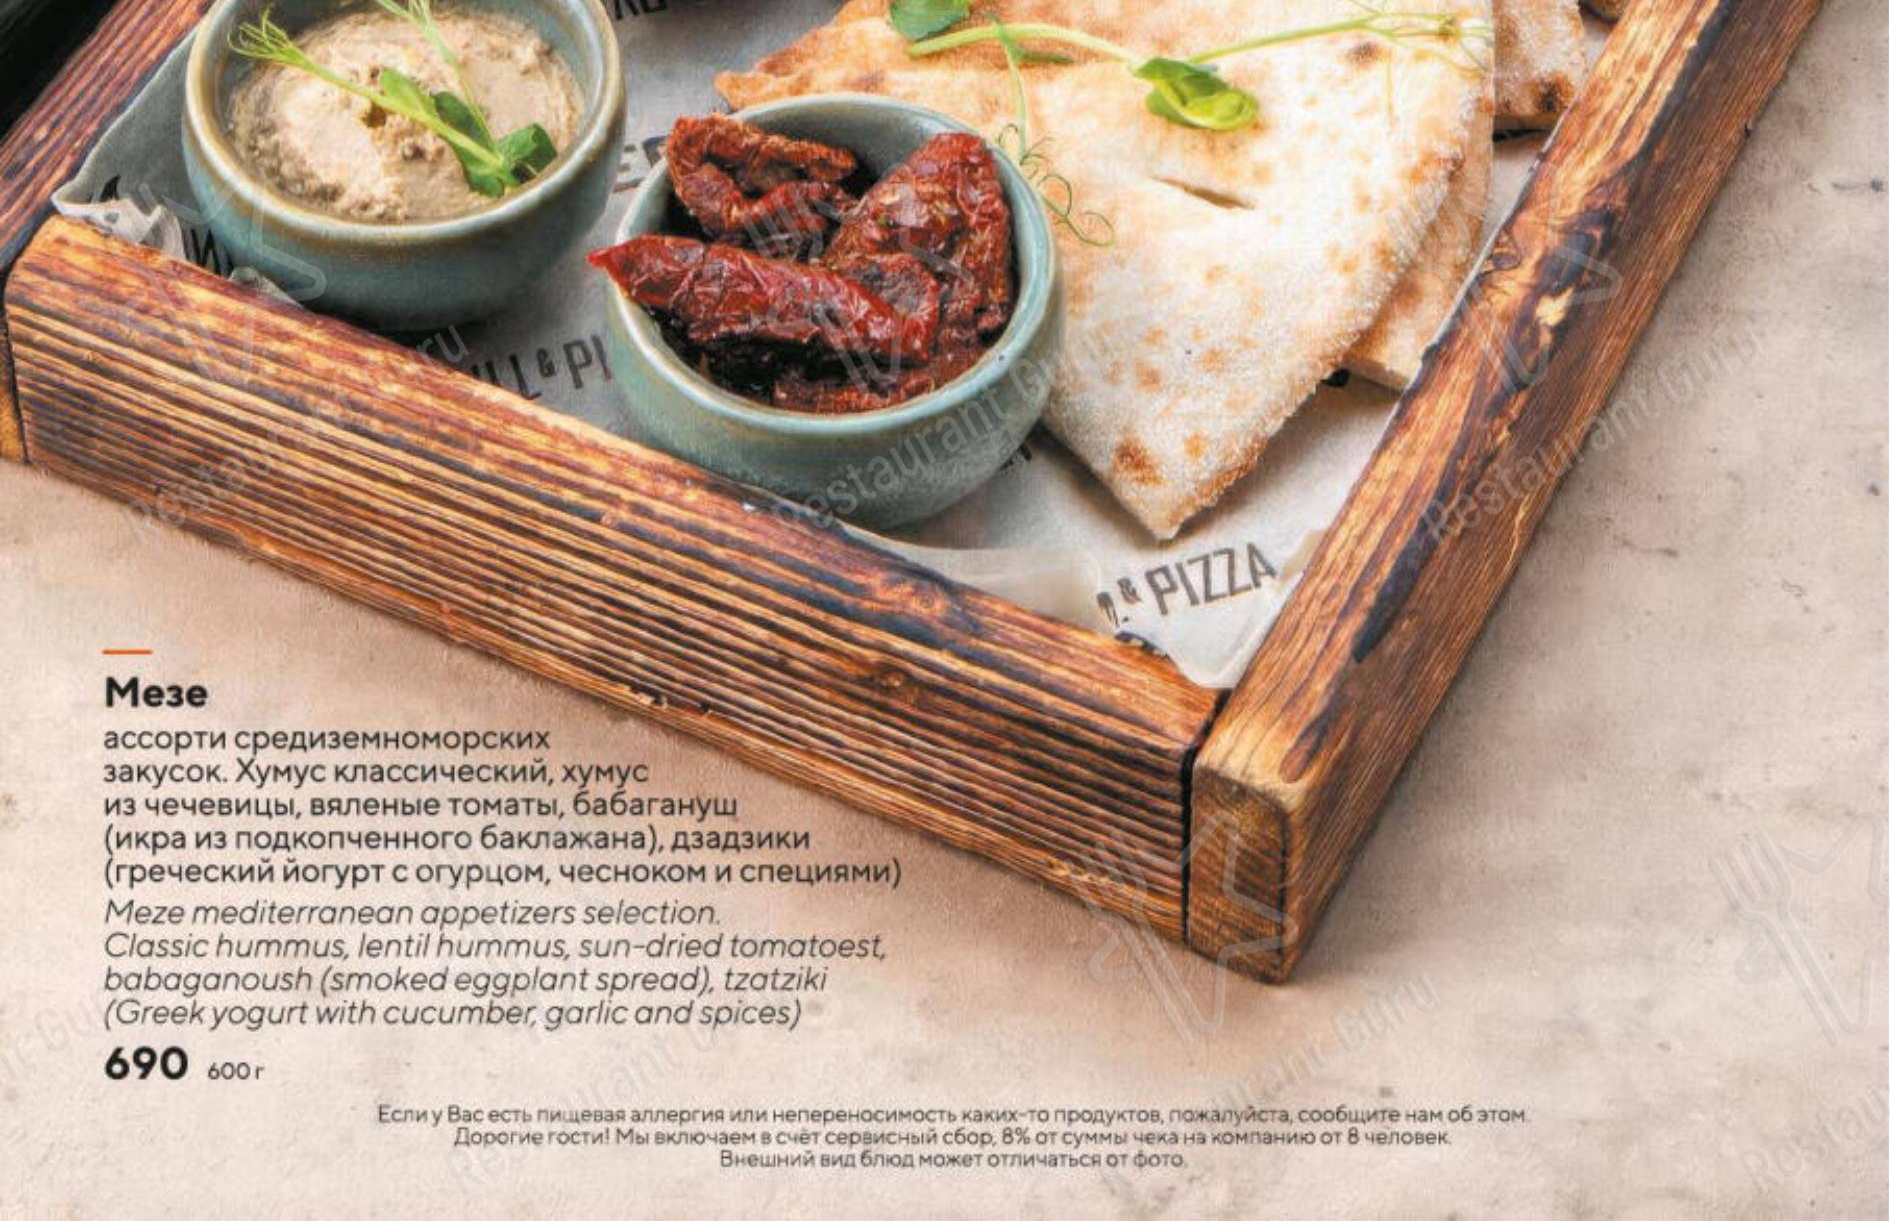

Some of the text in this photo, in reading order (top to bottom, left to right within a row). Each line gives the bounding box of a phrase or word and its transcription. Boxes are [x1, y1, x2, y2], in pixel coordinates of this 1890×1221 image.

[1145, 541, 1279, 617] PIZZA
[105, 675, 209, 709] Мезе
[103, 730, 551, 756] ассорти средиземноморских
[102, 756, 649, 789] закусок. Хумус классический, хумус
[103, 789, 738, 823] из чечевицы, вяленые томаты, бабагануш
[103, 822, 810, 857] (икра из подкопченного баклажана), дзадзики
[103, 855, 902, 891] (греческий йогурт с огурцом, чесноком и специями)
[104, 898, 721, 931] Meze mediterranean appetizers selection.
[103, 931, 886, 962] Classic hummus, lentil hummus, sun-dried tomatoest,
[103, 964, 829, 998] babaganoush (smoked eggplant spread), tzatziki
[103, 996, 802, 1033] (Greek yogurt with cucumber, garlic and spices)
[103, 1045, 265, 1081] 690 600 г
[377, 1103, 1526, 1127] Если у Вас есть пищевая аллергия или непереносимость каких-то продуктов, пожалуйста, сообщите нам об этом.
[453, 1126, 1452, 1149] Дорогие гости! Мы включаем в счёт сервисный сбор, 8% от суммы чека на компанию от 8 человек.
[720, 1149, 1185, 1169] Внешний вид блюд может отличаться от фото.
